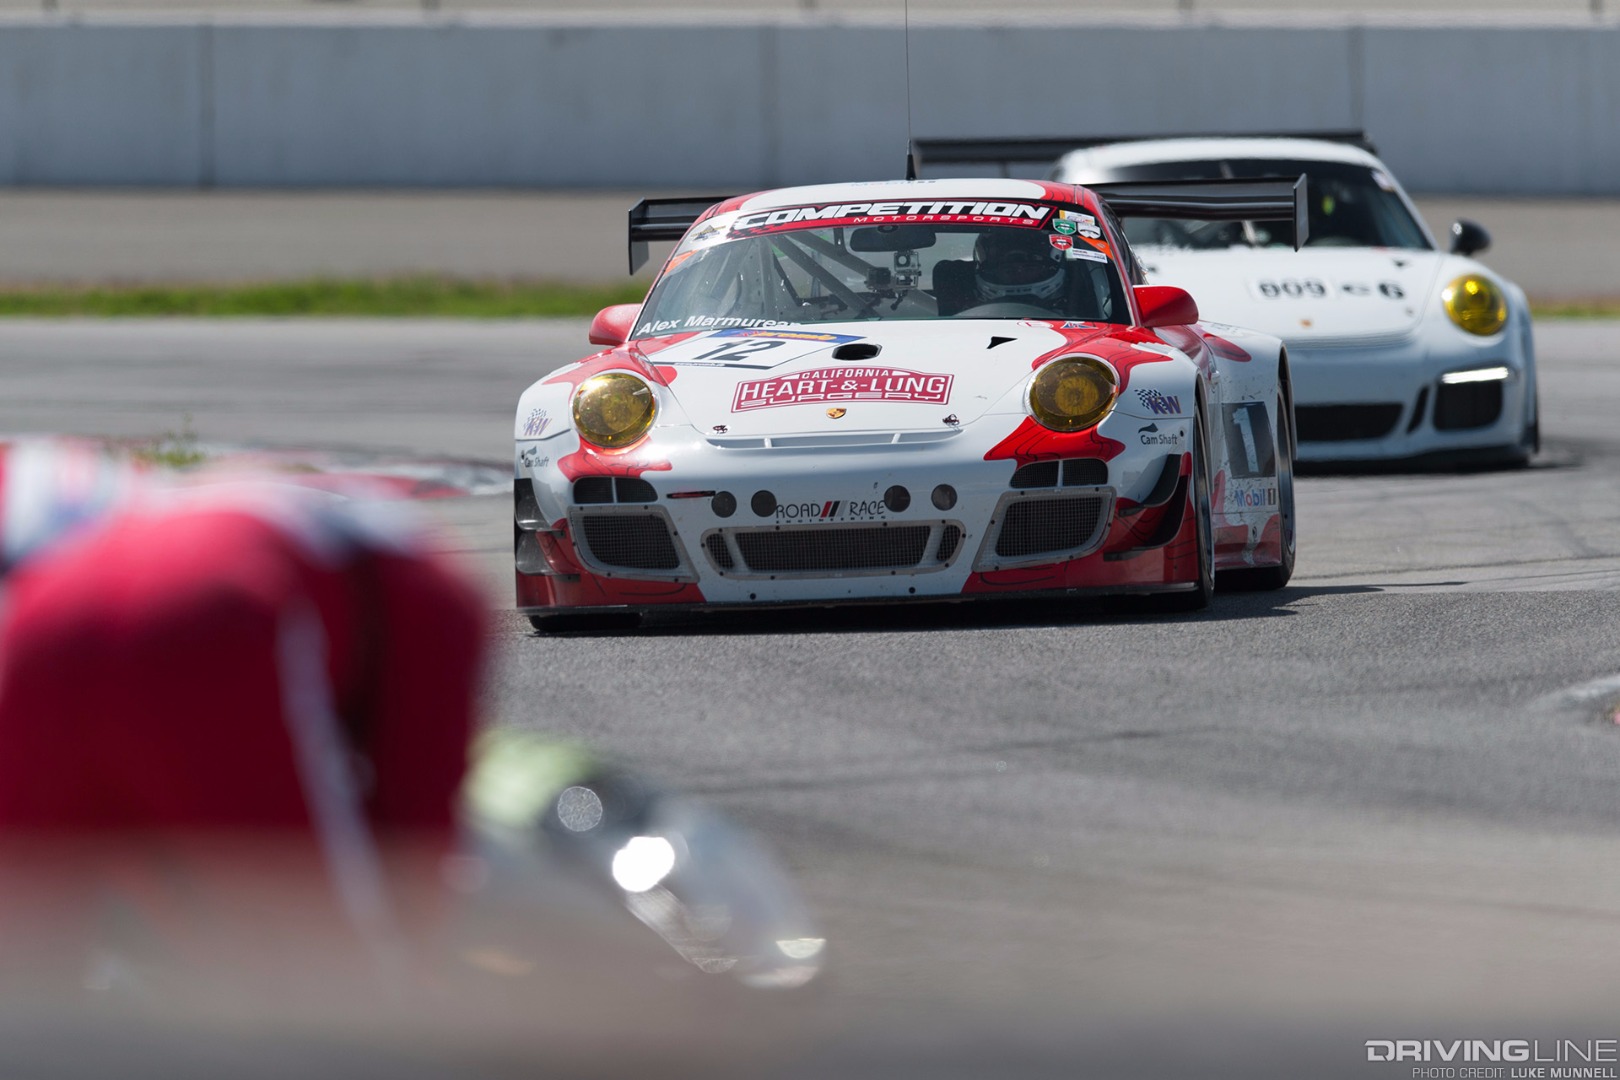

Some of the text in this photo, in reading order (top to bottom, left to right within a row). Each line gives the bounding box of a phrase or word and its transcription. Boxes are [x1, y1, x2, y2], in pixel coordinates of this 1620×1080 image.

[734, 201, 1050, 230] COMPETITION
[853, 215, 1035, 225] MOTORSPORTS
[636, 319, 682, 336] Alex
[692, 339, 787, 361] 12
[801, 369, 889, 379] CALIFORNIA
[740, 377, 945, 400] HEART-&-LUNG
[740, 391, 941, 408] SURGERY
[1147, 395, 1182, 414] KW
[1140, 434, 1178, 445] Cam Shaft
[1232, 407, 1260, 472] 1
[534, 456, 549, 467] Shaft
[1235, 488, 1276, 507] Mobil 1
[776, 500, 885, 518] ROAD RACE
